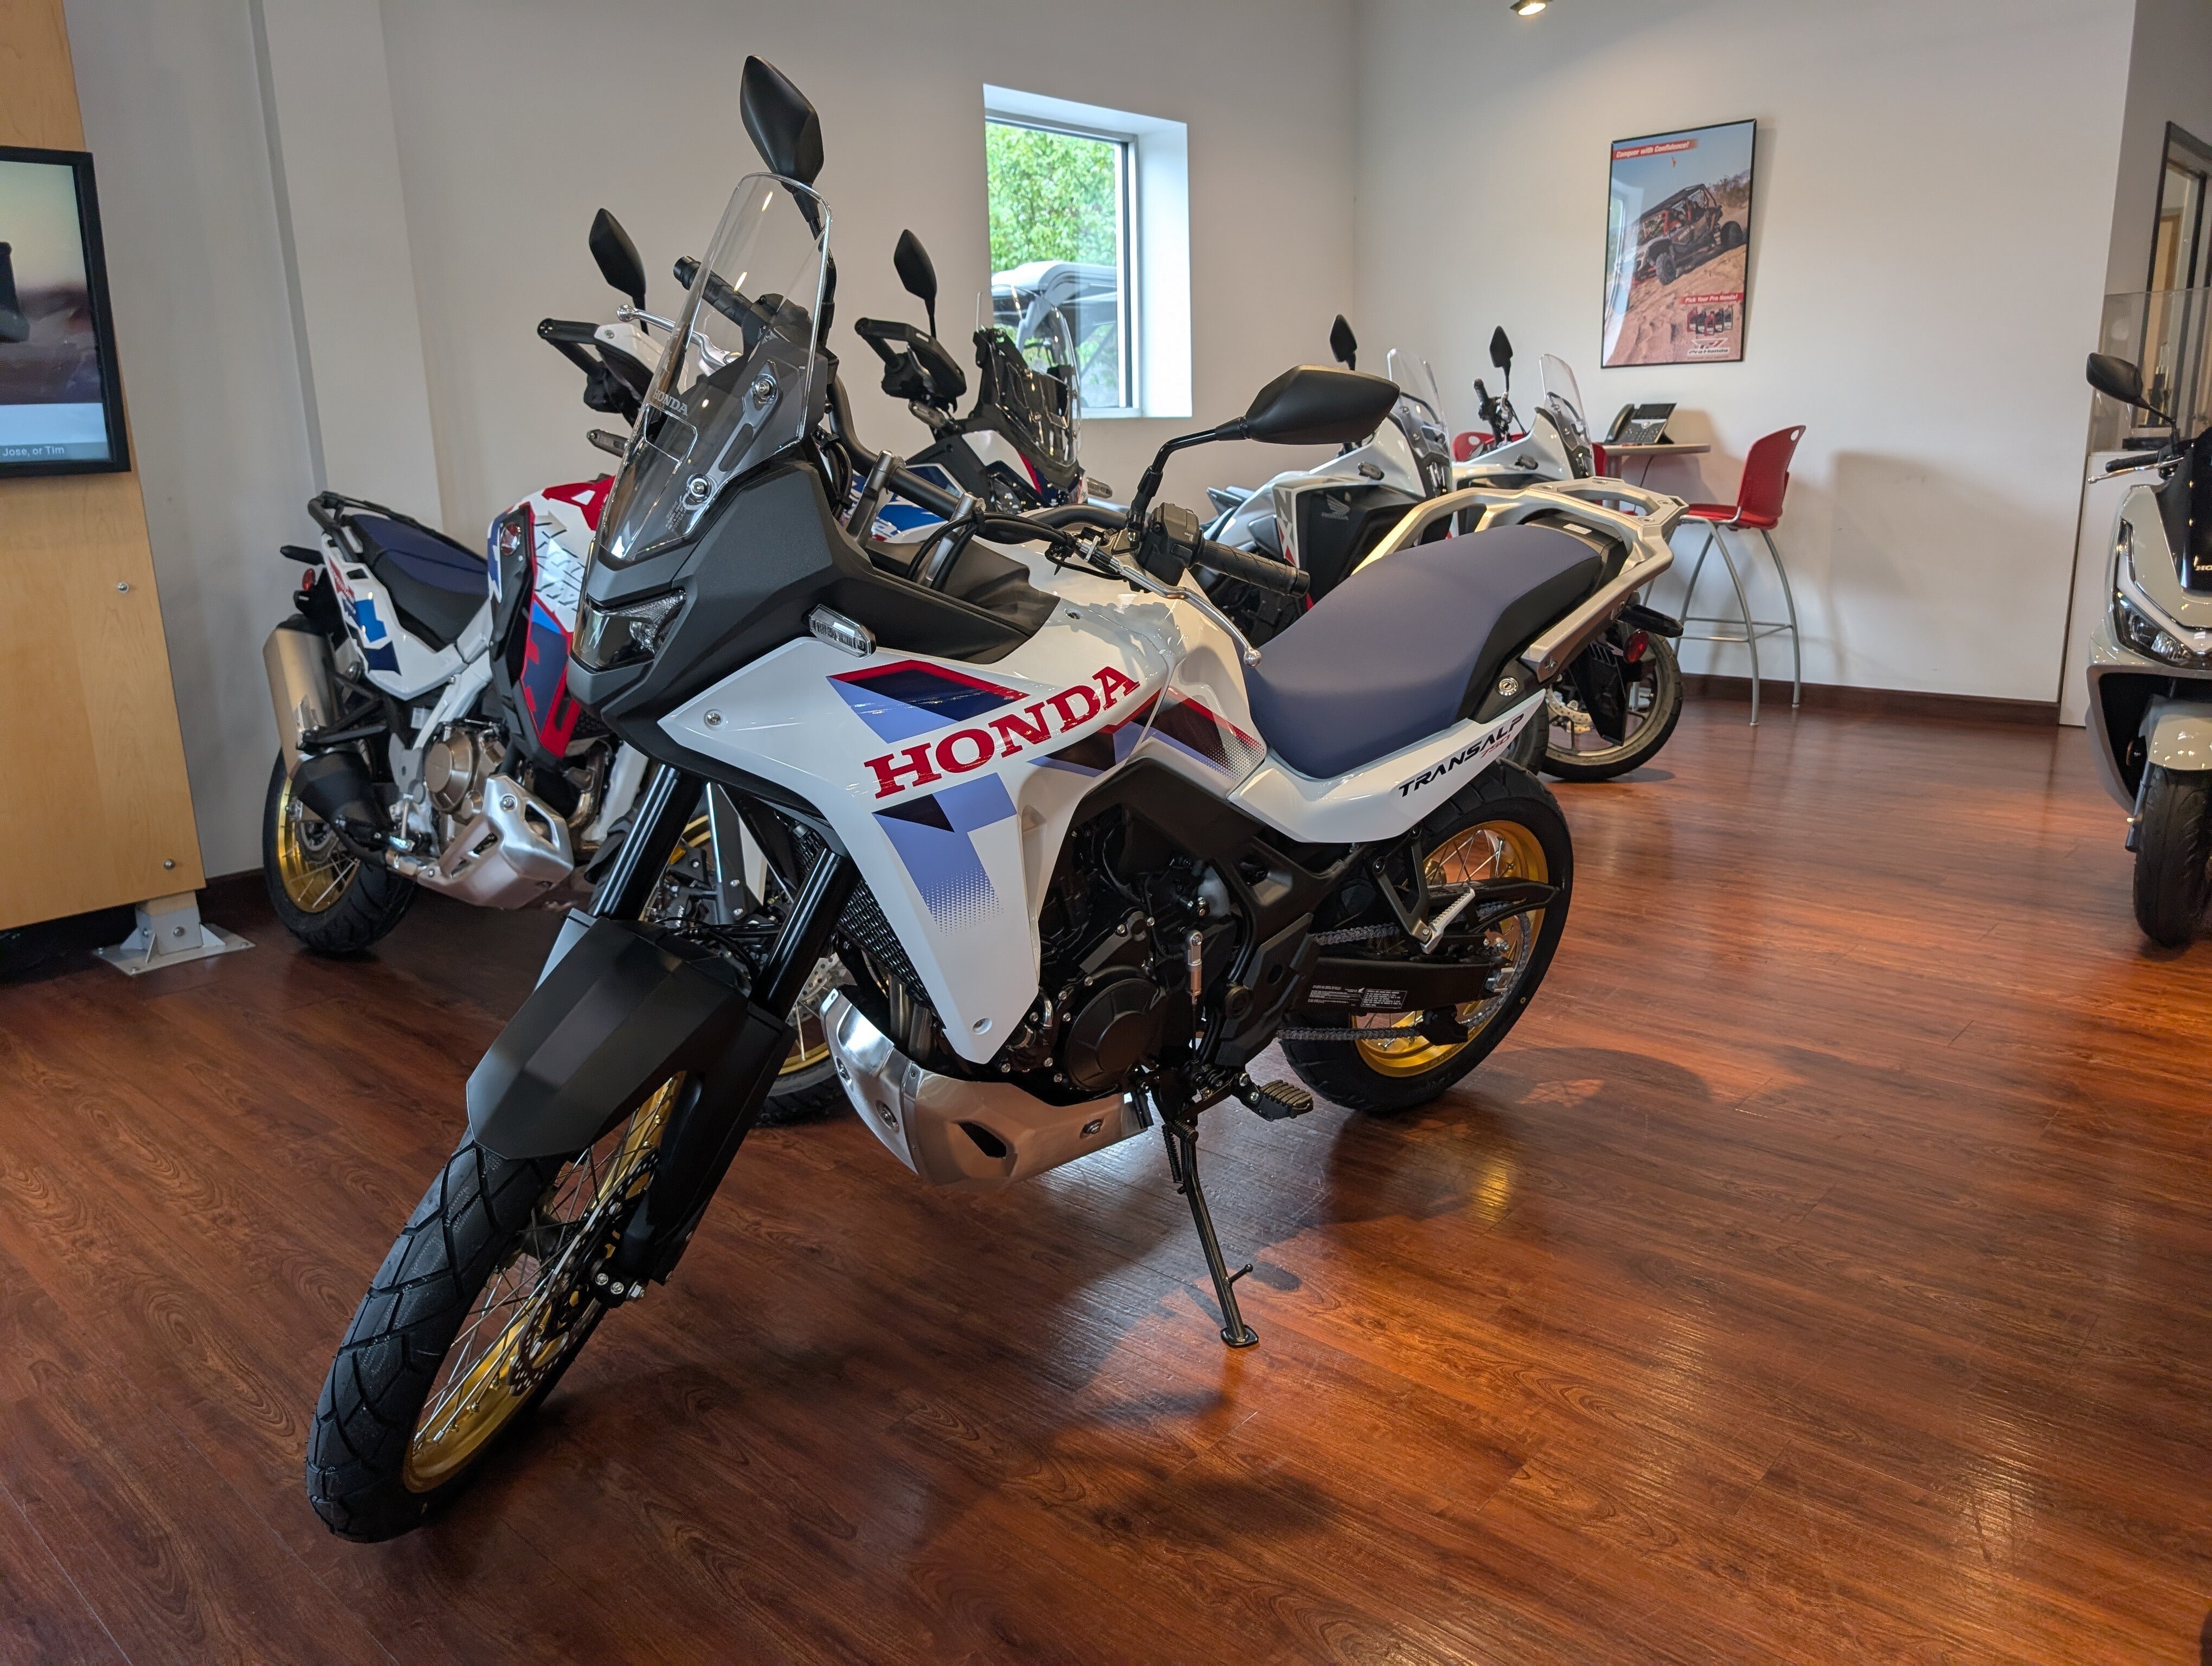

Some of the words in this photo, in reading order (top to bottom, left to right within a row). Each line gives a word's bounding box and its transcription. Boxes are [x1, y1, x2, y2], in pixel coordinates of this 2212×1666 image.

[652, 388, 688, 416] HONDA
[3, 447, 30, 457] Jose,
[44, 445, 65, 454] Tim
[864, 665, 1141, 799] HONDA
[1398, 713, 1525, 798] TRANSALP
[1480, 734, 1510, 759] 750
